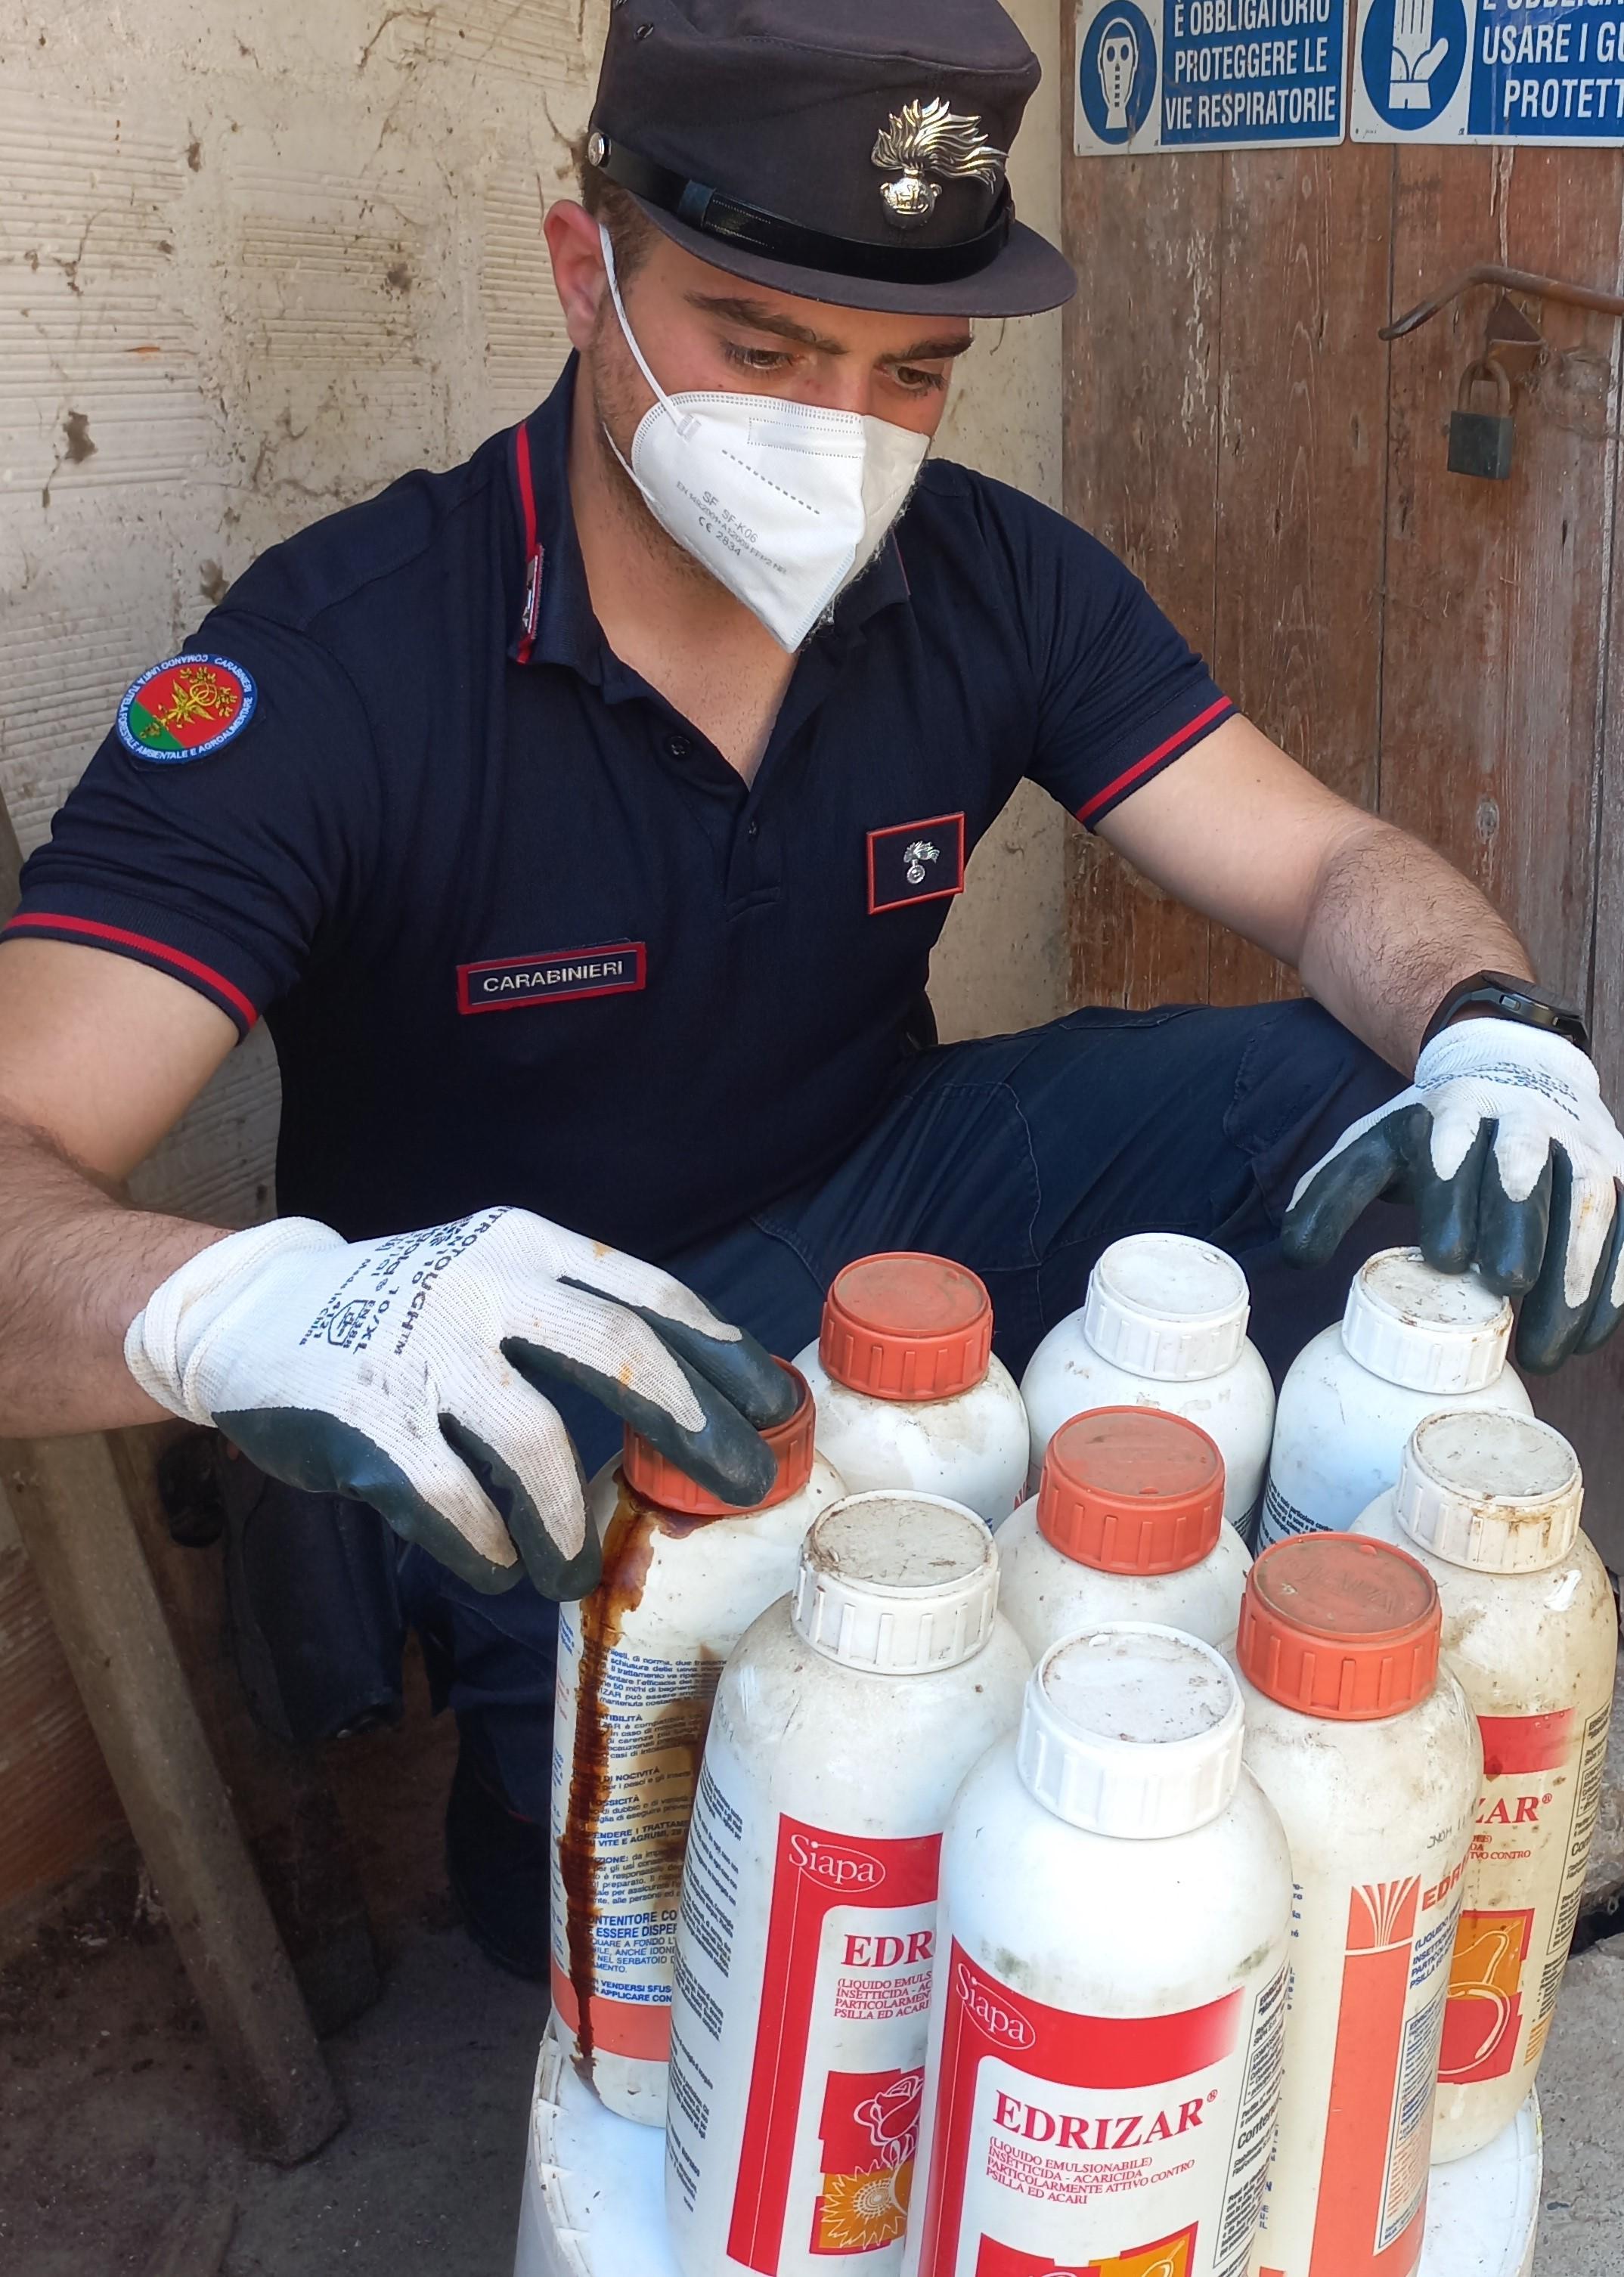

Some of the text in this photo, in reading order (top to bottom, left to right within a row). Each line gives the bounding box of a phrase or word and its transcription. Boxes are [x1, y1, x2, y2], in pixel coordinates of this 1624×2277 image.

[1174, 0, 1330, 37] È OBBLIGATORIO
[1483, 23, 1572, 65] USARE
[1579, 23, 1588, 62] I
[1175, 36, 1328, 84] PROTEGGERE LE
[1165, 85, 1336, 130] VIE RESPIRATORIE
[702, 491, 758, 544] SF SF-K06
[716, 532, 741, 556] 2834
[163, 654, 209, 671] COMANDO
[214, 657, 253, 692] CARABINIERI
[119, 683, 141, 712] TUTELA
[136, 745, 188, 761] AMBIENTALE
[190, 748, 197, 756] E
[482, 960, 623, 993] CARABINIERI
[789, 1834, 876, 1885] Siapa
[1490, 1850, 1531, 1860] CONTRO
[596, 1928, 640, 1939] ESSERE
[615, 1947, 647, 1957] ANCHE
[616, 1956, 668, 1966] SERBATOIO
[600, 1979, 645, 1992] VENDERSI
[600, 1989, 650, 2002] APPLICARE
[836, 1987, 910, 2000] INSETTICIDA
[838, 1978, 892, 1990] (LIQUIDO
[833, 2000, 929, 2020] PSILLA ED ACARI
[956, 1963, 1027, 2044] Siapa
[988, 2145, 1062, 2182] INSETTICIDA
[1073, 2169, 1142, 2184] ACARICIDA
[989, 2136, 1153, 2173] (LIQUIDO EMULSIONABILE)
[985, 2166, 1088, 2205] PSILLA ED ACARI
[987, 2155, 1195, 2194] PARTICOLARMENTE ATTIVO CONTRO
